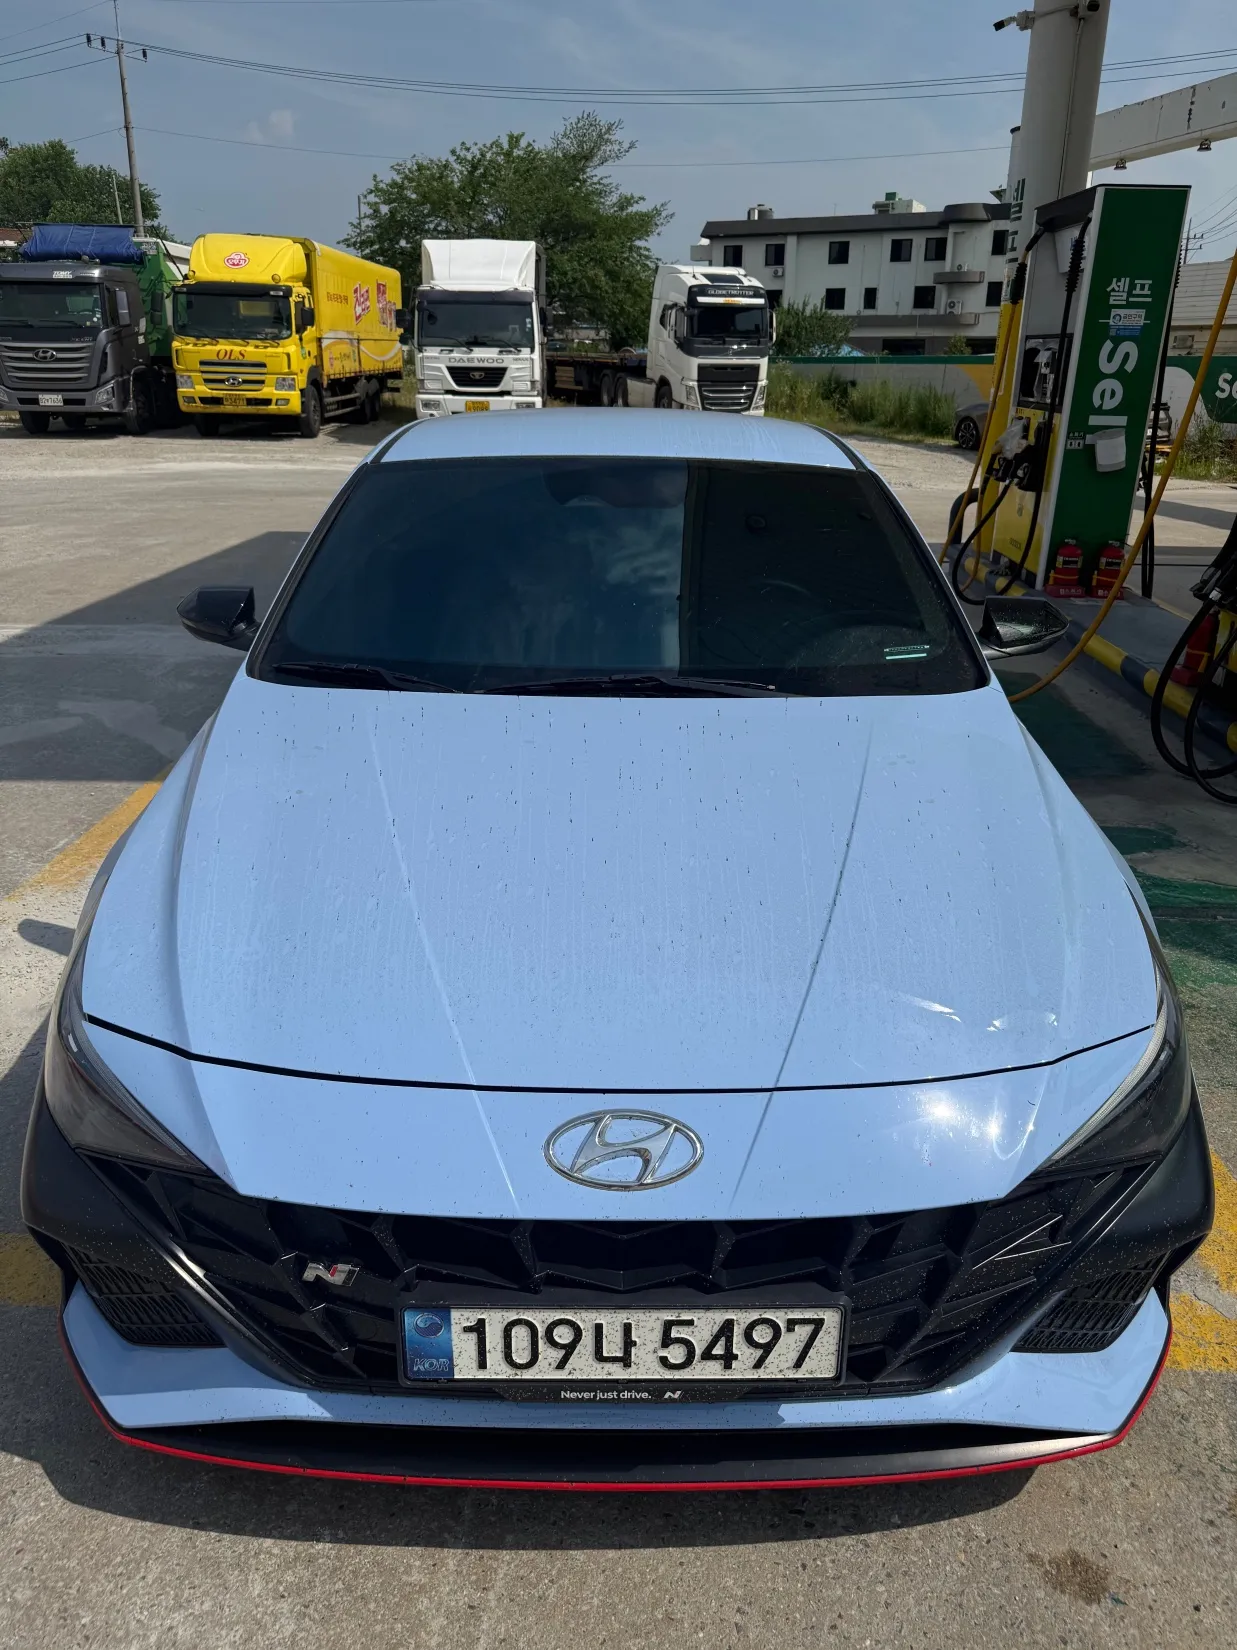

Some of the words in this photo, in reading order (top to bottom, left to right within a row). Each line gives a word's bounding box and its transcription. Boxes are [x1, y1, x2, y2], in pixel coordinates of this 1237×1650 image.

[1106, 277, 1153, 305] 셀프
[1122, 313, 1143, 321] 금연구역
[216, 348, 247, 361] OLS
[1084, 338, 1139, 446] Sel
[462, 1316, 638, 1370] 109나
[658, 1317, 826, 1371] 5497
[413, 1358, 450, 1372] KOR
[560, 1390, 595, 1399] Never
[596, 1390, 618, 1400] just
[619, 1390, 652, 1399] drive.
